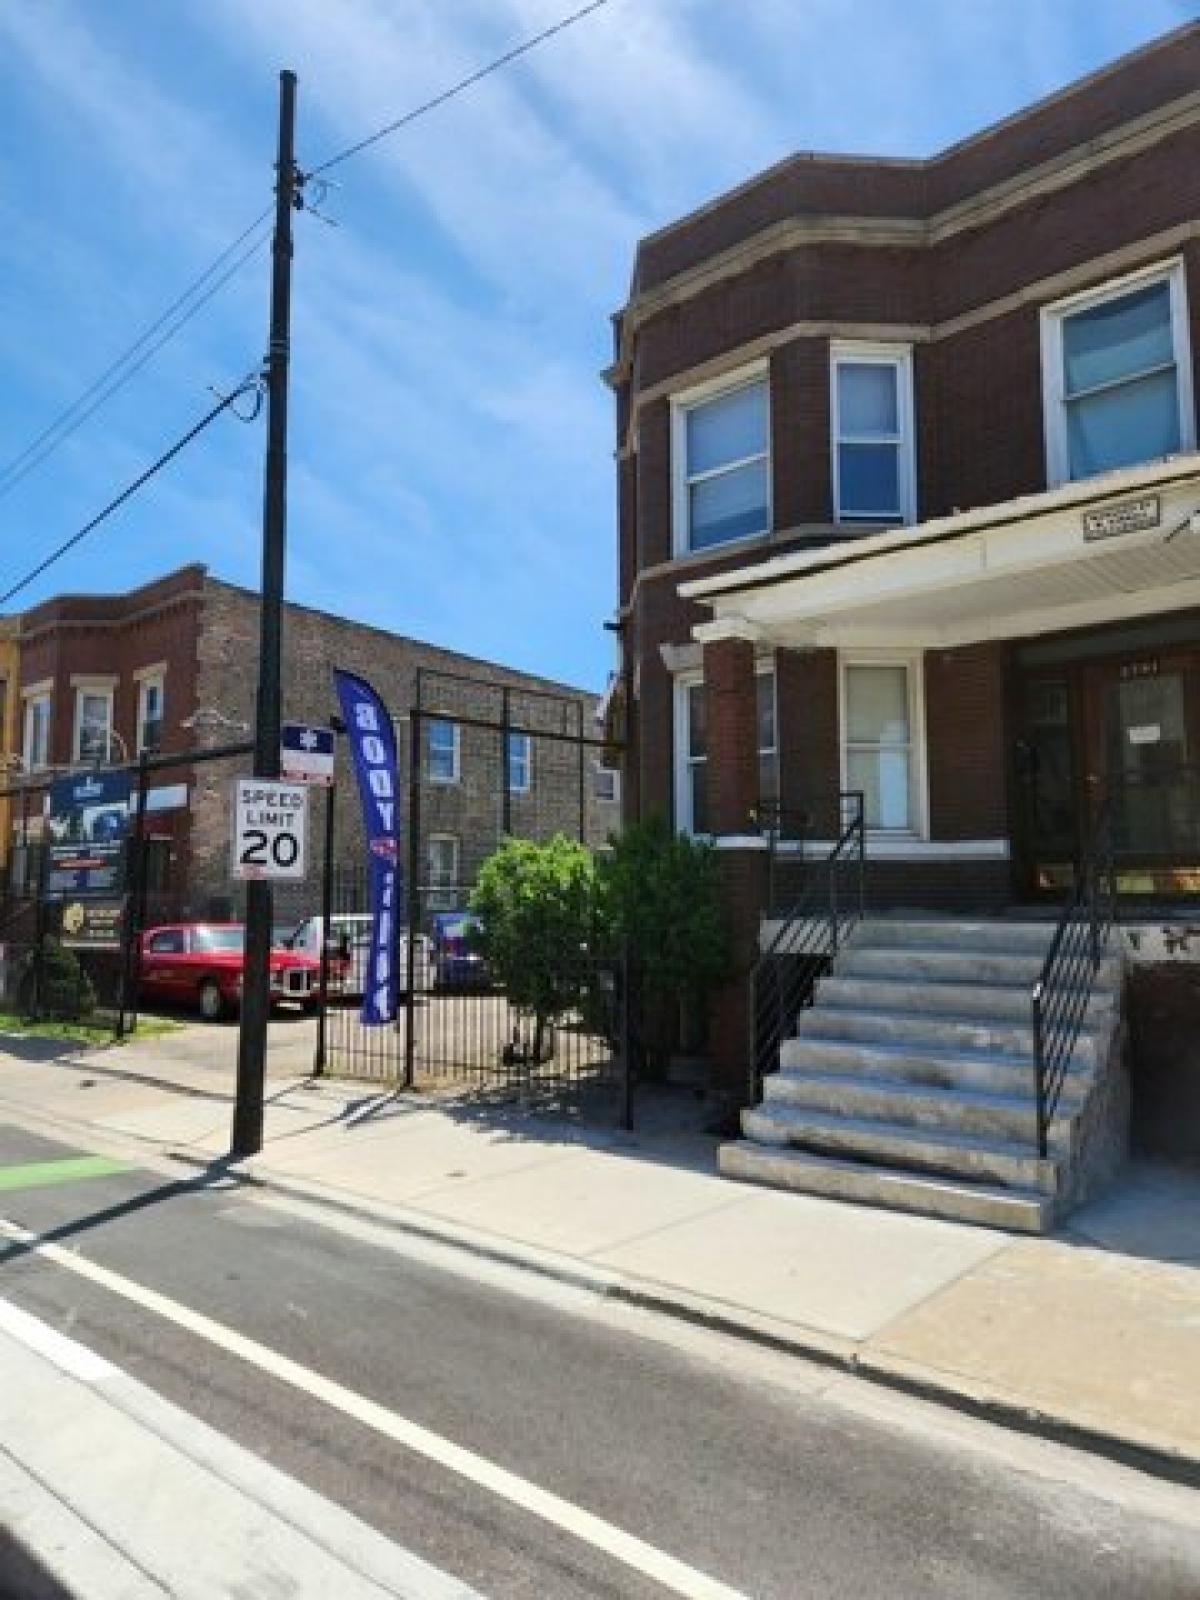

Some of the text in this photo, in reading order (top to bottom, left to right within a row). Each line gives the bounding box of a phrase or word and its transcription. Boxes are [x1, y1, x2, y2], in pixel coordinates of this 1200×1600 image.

[242, 789, 304, 811] SPEED
[246, 809, 295, 828] LIMIT
[240, 829, 298, 868] 20
